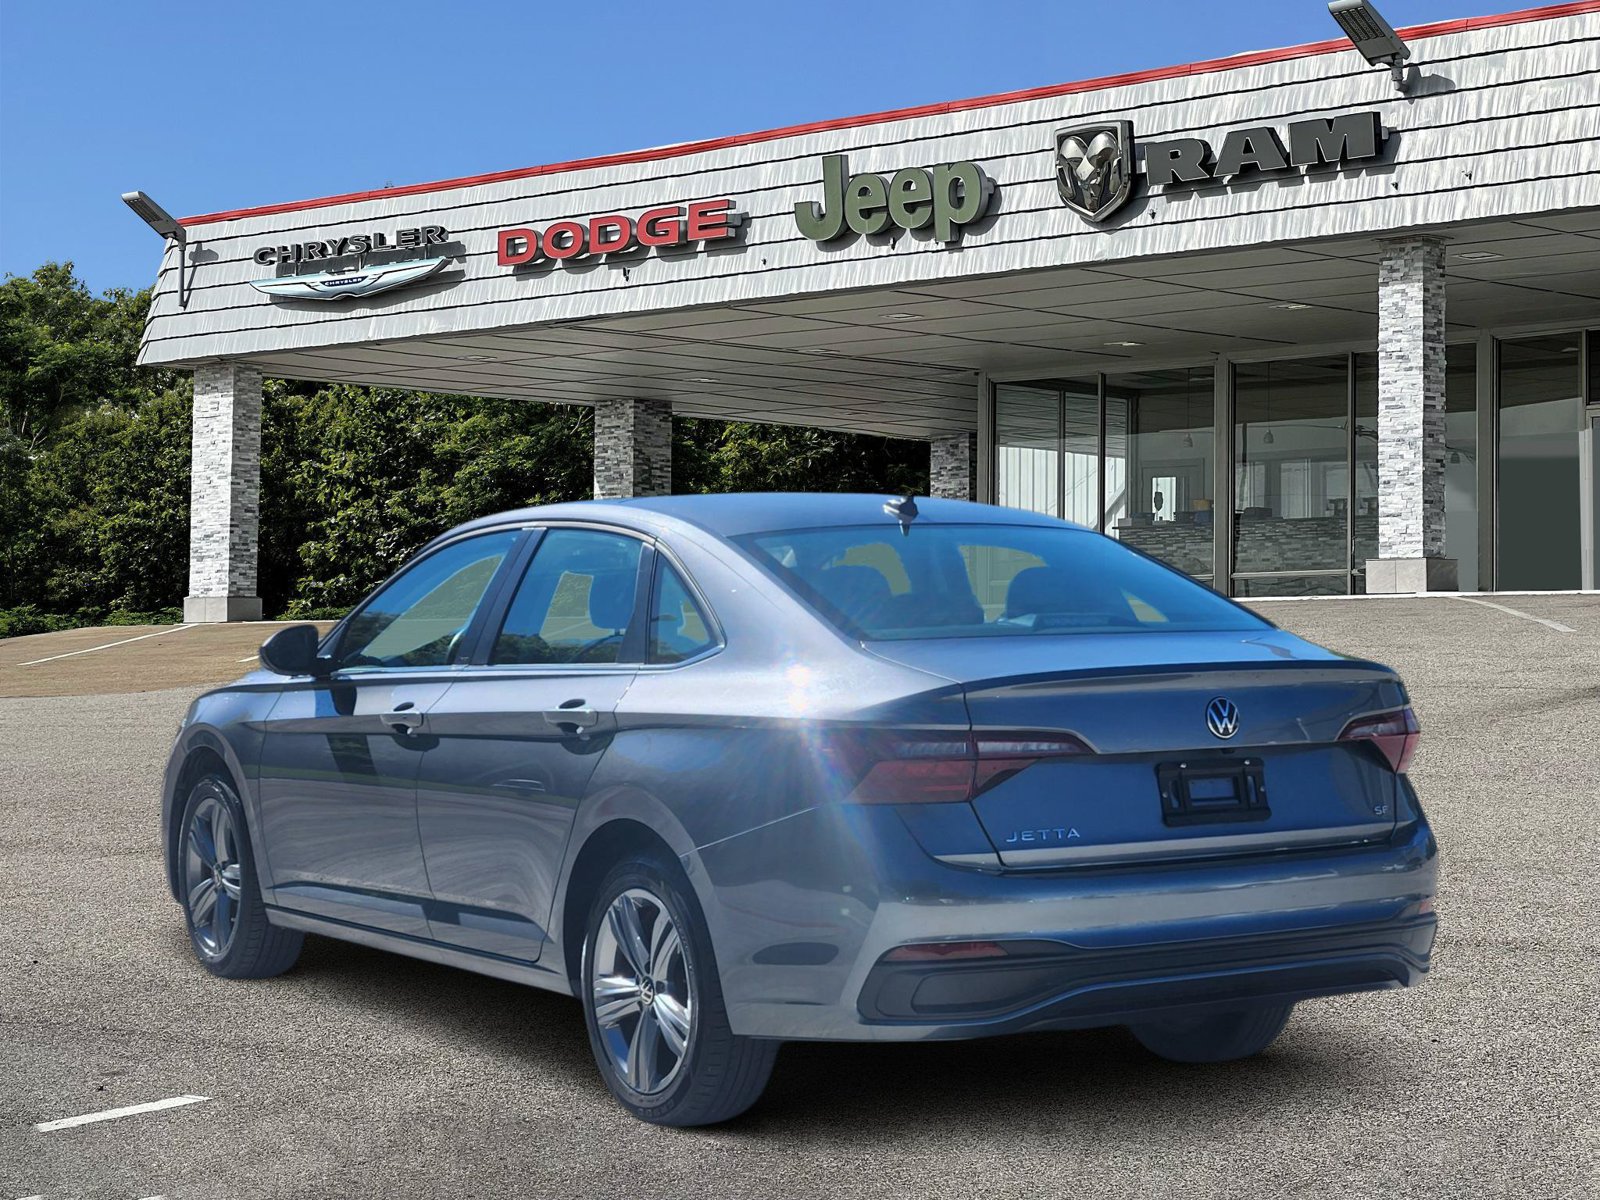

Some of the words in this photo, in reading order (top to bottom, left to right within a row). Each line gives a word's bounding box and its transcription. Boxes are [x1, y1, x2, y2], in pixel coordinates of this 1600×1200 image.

[1145, 112, 1380, 186] RAM
[795, 155, 990, 242] Jeep
[253, 225, 449, 267] CHRYSLER
[497, 199, 735, 267] DODGE
[324, 277, 363, 286] CHRYSLER
[1207, 697, 1239, 739] VW
[1005, 827, 1081, 843] JETTA
